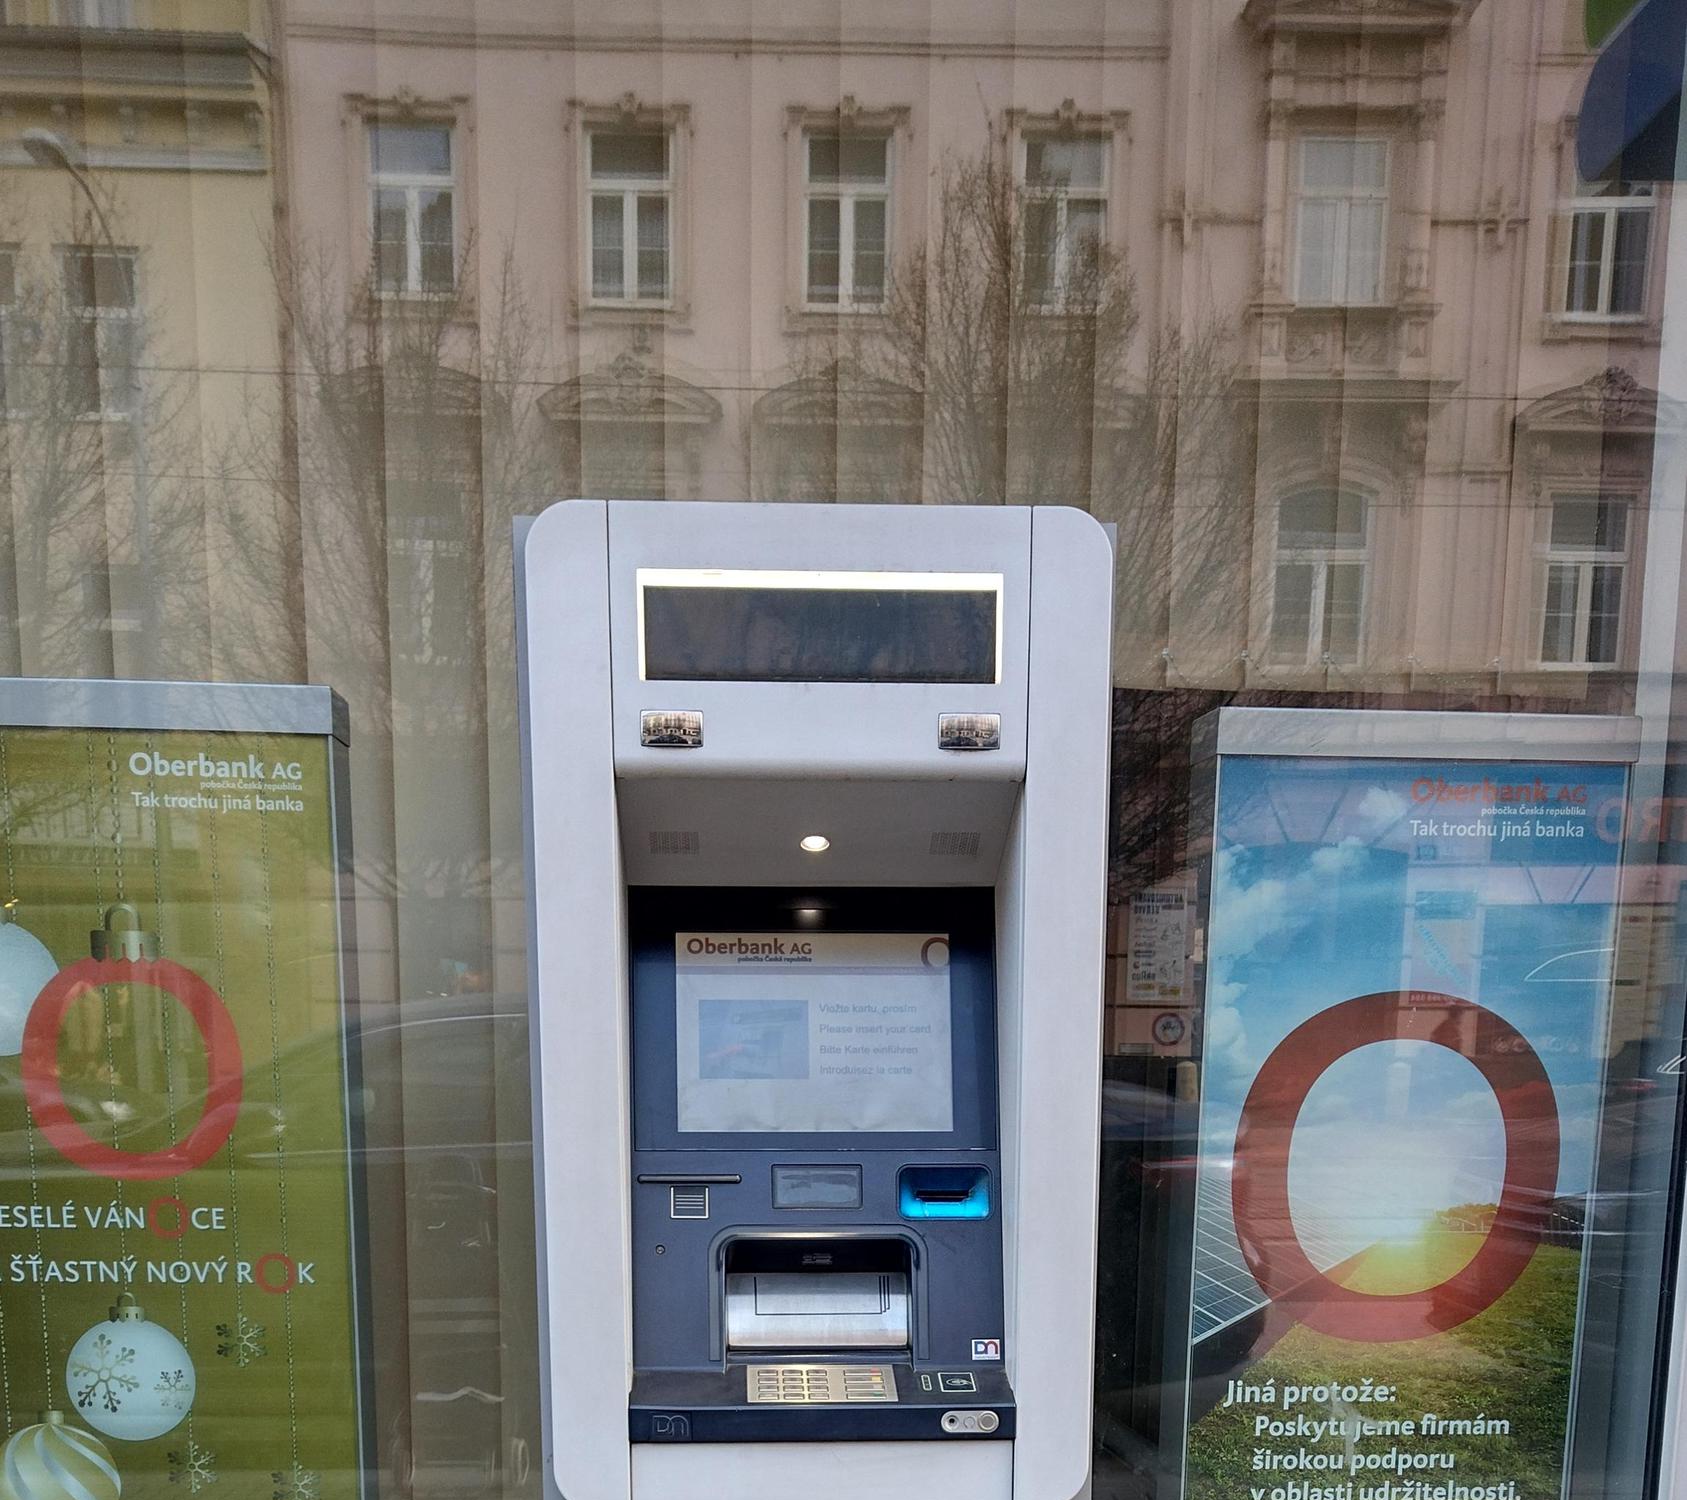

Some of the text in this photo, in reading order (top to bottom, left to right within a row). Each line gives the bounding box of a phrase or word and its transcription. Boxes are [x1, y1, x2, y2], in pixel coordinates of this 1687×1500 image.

[128, 751, 302, 780] Oberbank AG
[1411, 776, 1588, 804] Oberbank AG
[131, 791, 304, 814] Tak trochu jiná banka
[1481, 804, 1586, 818] pobočka Česká republika
[1409, 819, 1585, 842] Tak trochu jiná banka
[686, 937, 813, 956] Oberbank AG
[819, 1023, 932, 1036] Please insert your card
[820, 1045, 842, 1055] Bitte
[844, 1045, 871, 1055] Karte
[84, 1197, 226, 1239] VÁNOCE
[10, 1253, 315, 1294] ŠŤASTNÝ NOVÝ ROK
[1223, 1378, 1397, 1410] Jiná protože:
[1421, 1413, 1511, 1436] firmám
[1252, 1448, 1455, 1476] širokou podporu
